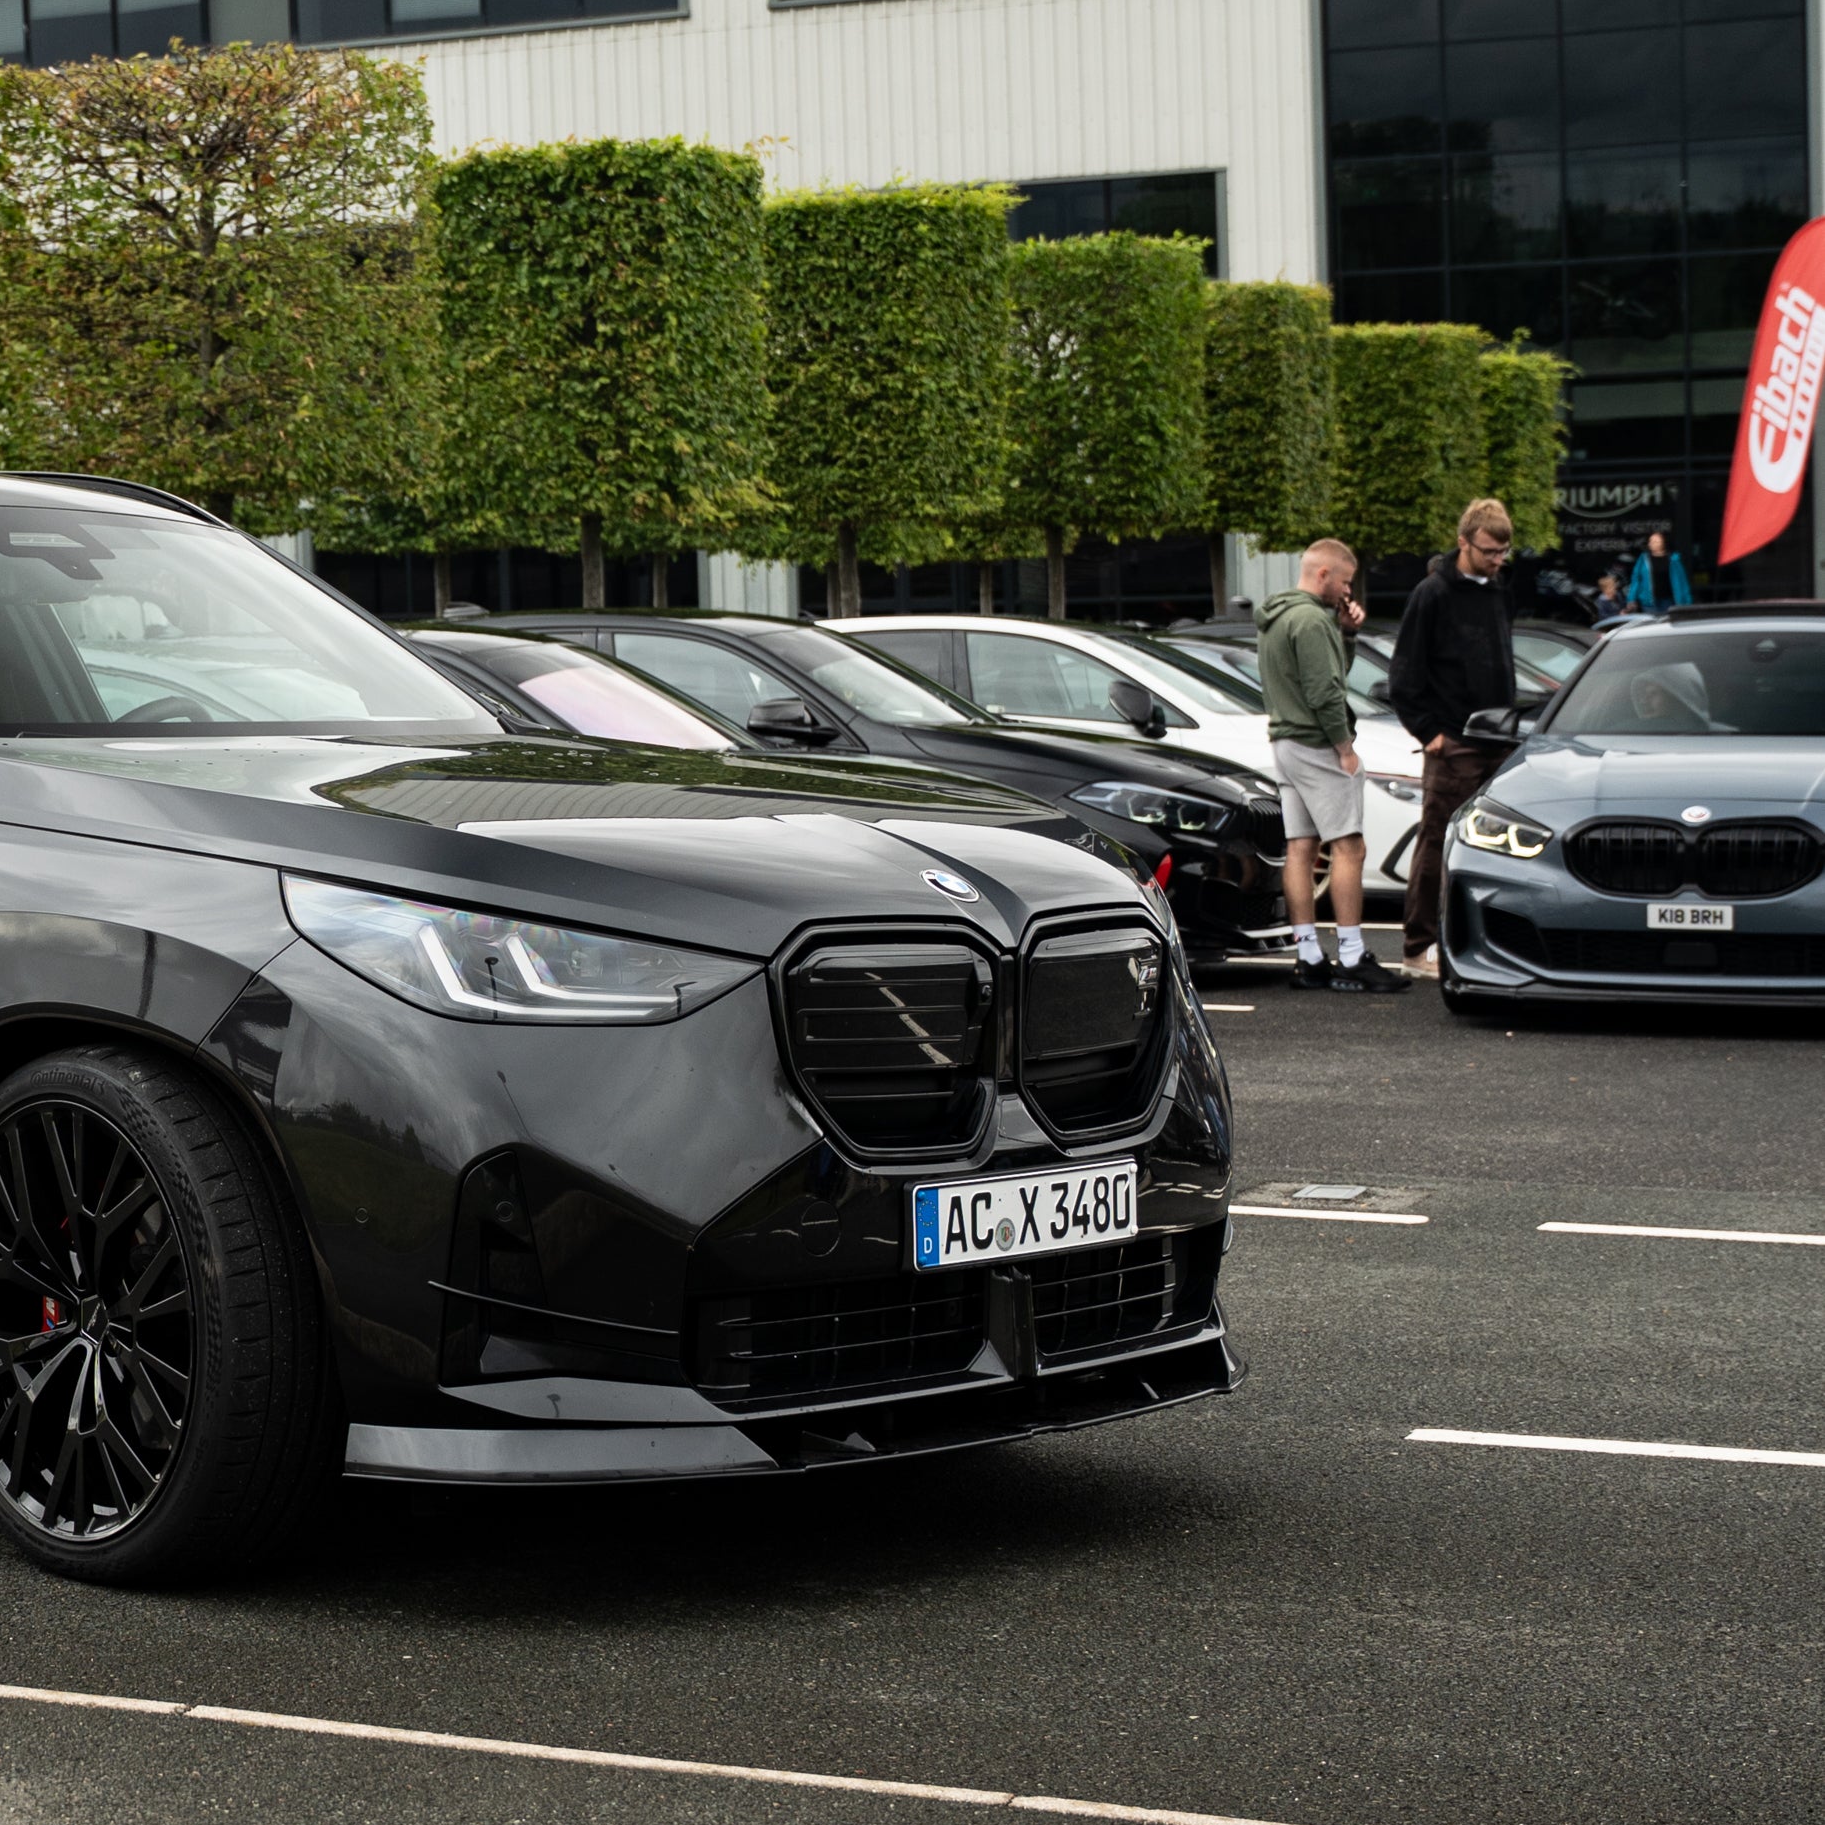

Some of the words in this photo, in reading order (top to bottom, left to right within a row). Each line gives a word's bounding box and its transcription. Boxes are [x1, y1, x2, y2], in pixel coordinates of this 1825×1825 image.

[1748, 285, 1817, 493] Eibach
[1658, 908, 1685, 924] K18
[1690, 909, 1723, 925] BRH
[944, 1192, 994, 1255] AC
[1019, 1185, 1040, 1245] X
[1050, 1173, 1130, 1240] 3480
[923, 1236, 933, 1254] D
